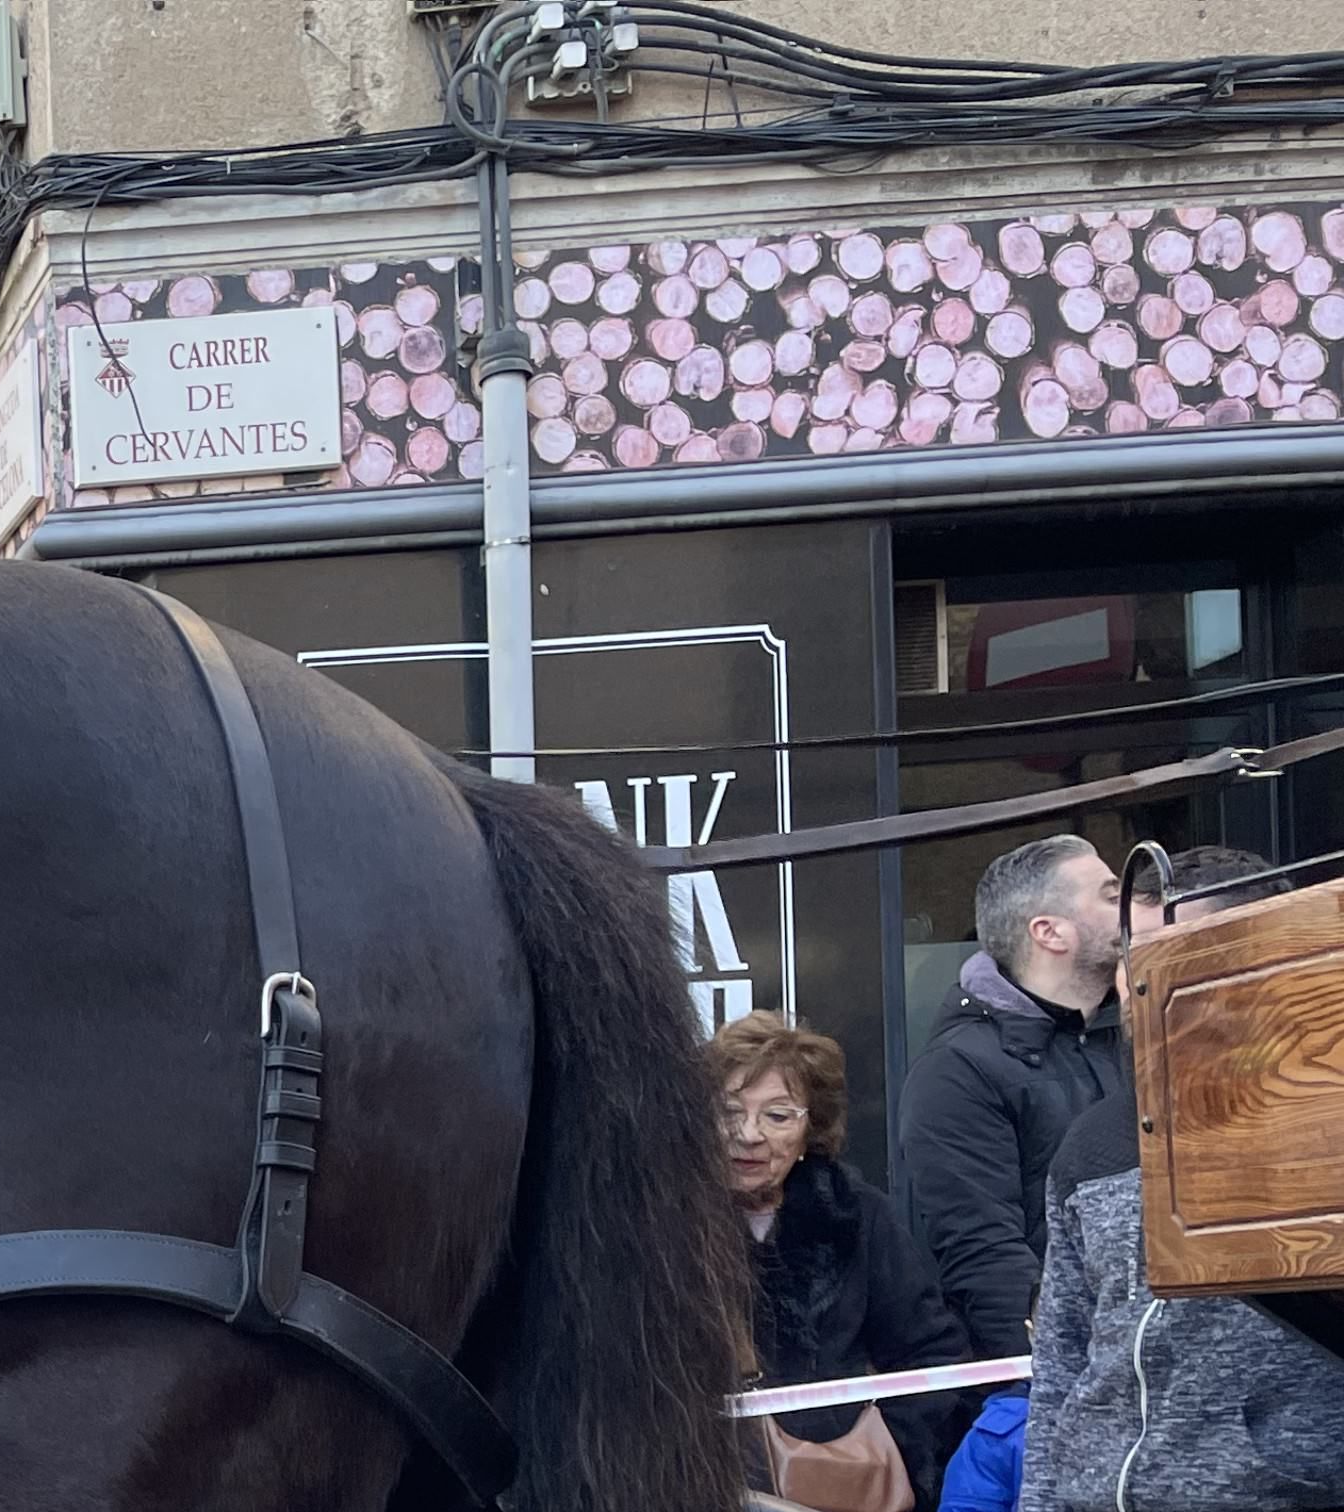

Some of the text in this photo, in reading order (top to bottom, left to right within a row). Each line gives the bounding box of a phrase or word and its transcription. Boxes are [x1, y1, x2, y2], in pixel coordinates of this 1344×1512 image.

[169, 336, 271, 371] CARRER
[185, 382, 235, 413] DE
[105, 420, 308, 466] CERVANTES
